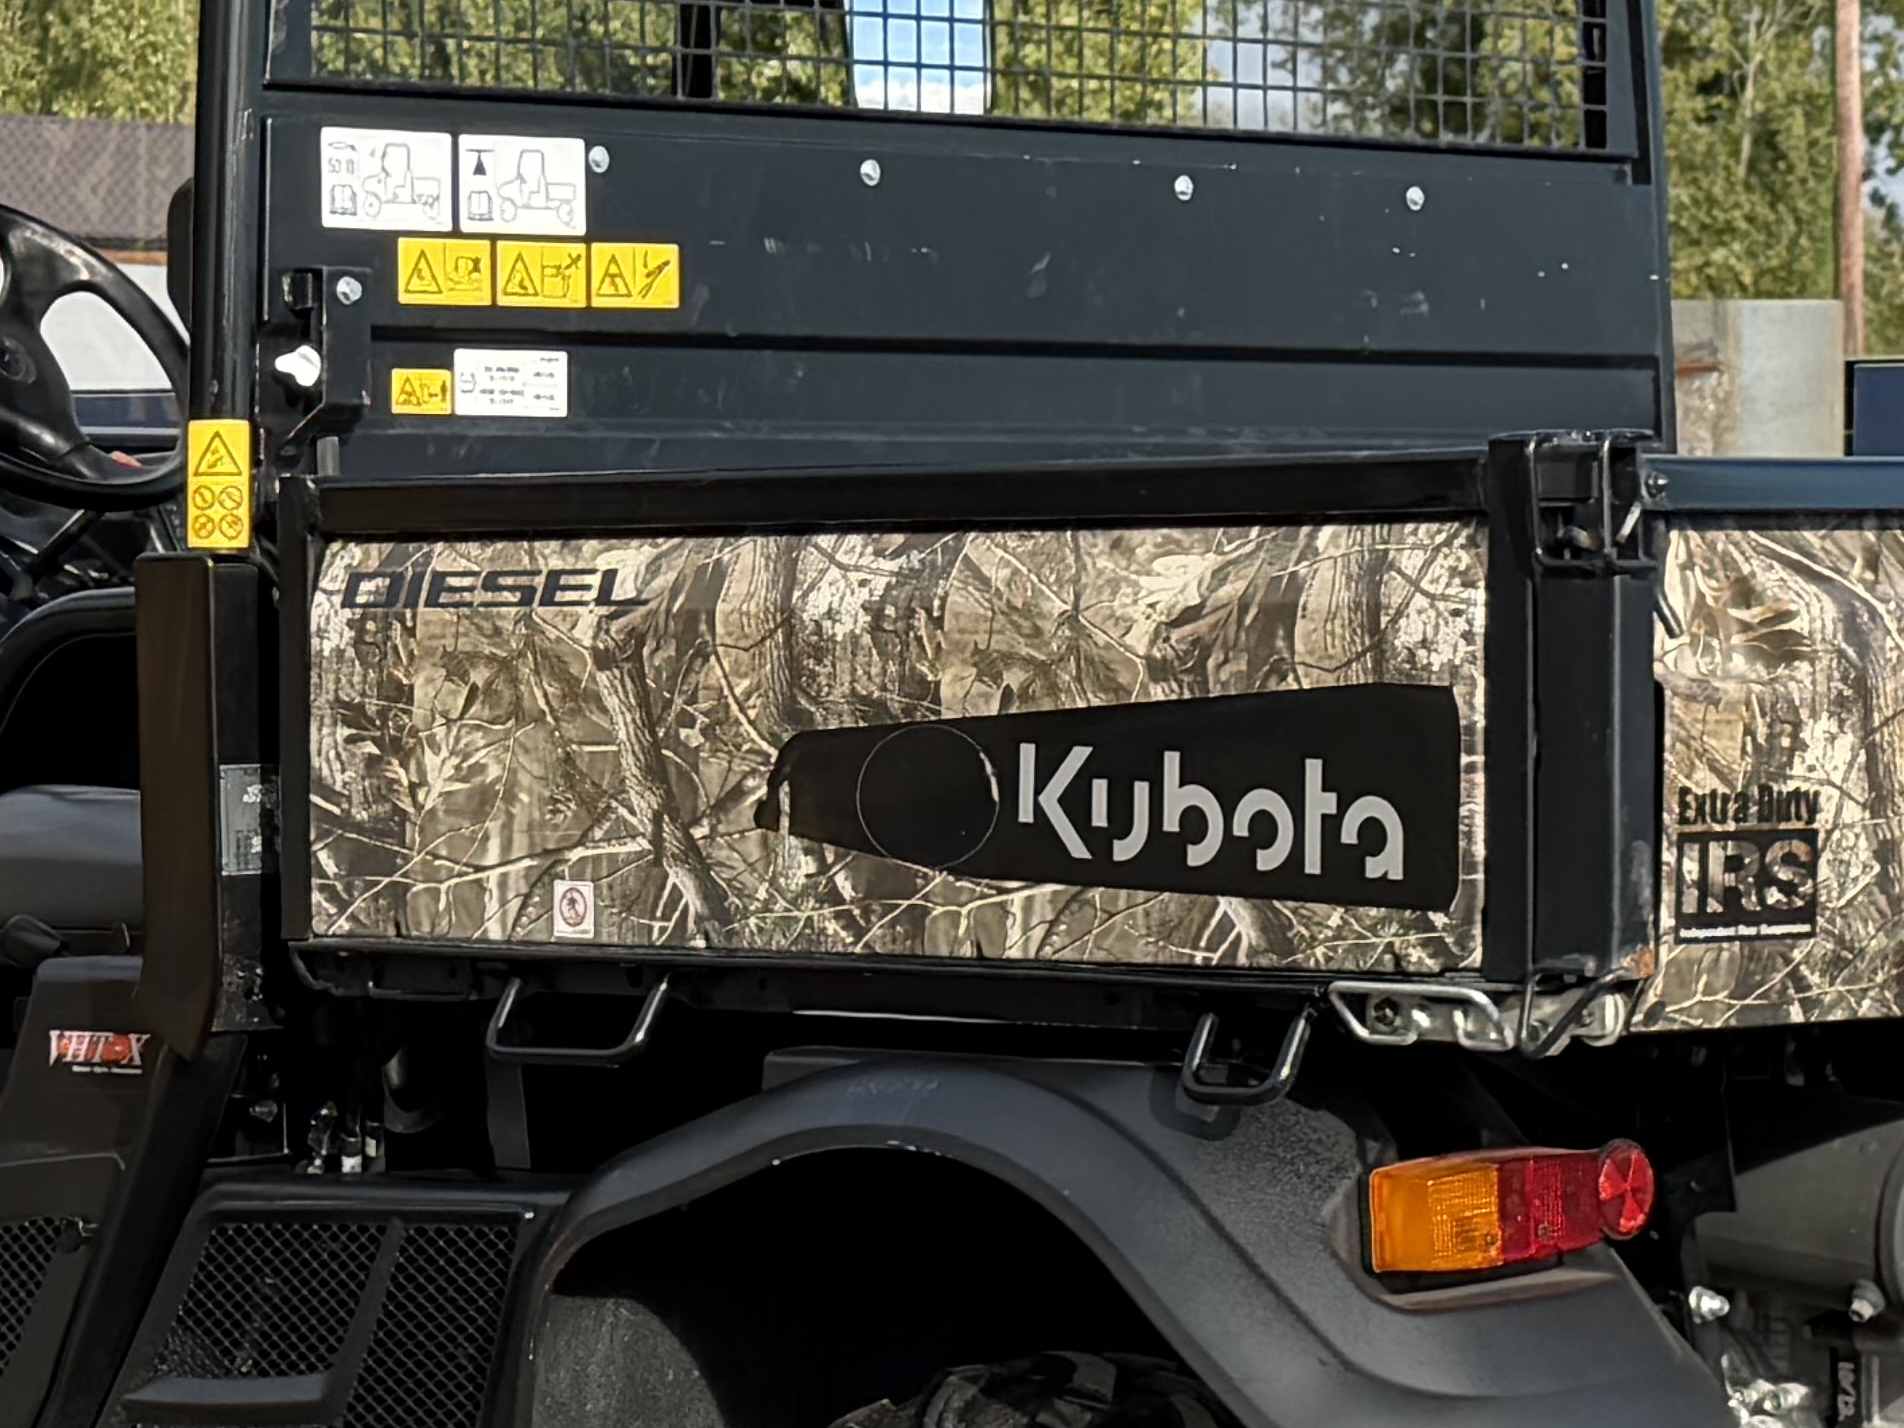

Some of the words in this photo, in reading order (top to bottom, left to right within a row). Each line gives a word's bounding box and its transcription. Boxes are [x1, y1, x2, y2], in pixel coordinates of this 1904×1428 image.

[340, 568, 650, 609] DIESEL
[1017, 741, 1404, 881] Kubota
[1681, 838, 1815, 914] IRS
